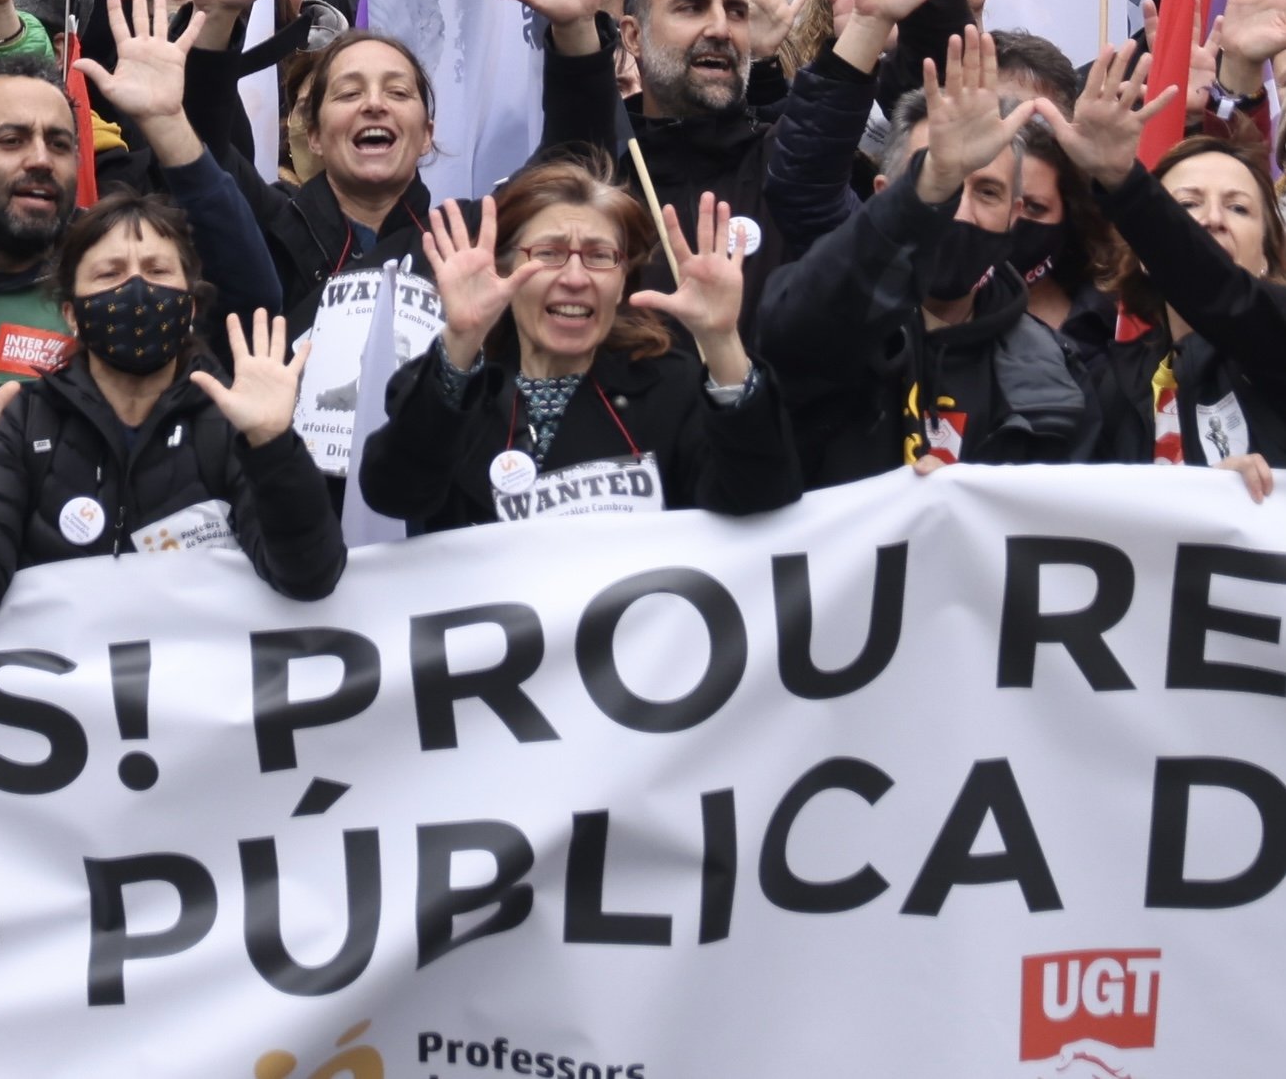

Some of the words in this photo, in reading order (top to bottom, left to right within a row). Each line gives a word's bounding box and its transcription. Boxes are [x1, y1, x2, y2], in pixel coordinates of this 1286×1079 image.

[1025, 255, 1054, 284] CGT
[5, 333, 44, 350] INTER
[398, 308, 436, 331] Cambray
[500, 468, 655, 522] WANTED
[592, 502, 634, 514] Cambray
[249, 541, 909, 774] PROU
[996, 535, 1286, 699] RE
[83, 755, 1065, 1007] PÚBLICA
[1040, 957, 1161, 1019] UGT
[416, 1030, 646, 1079] Professors
